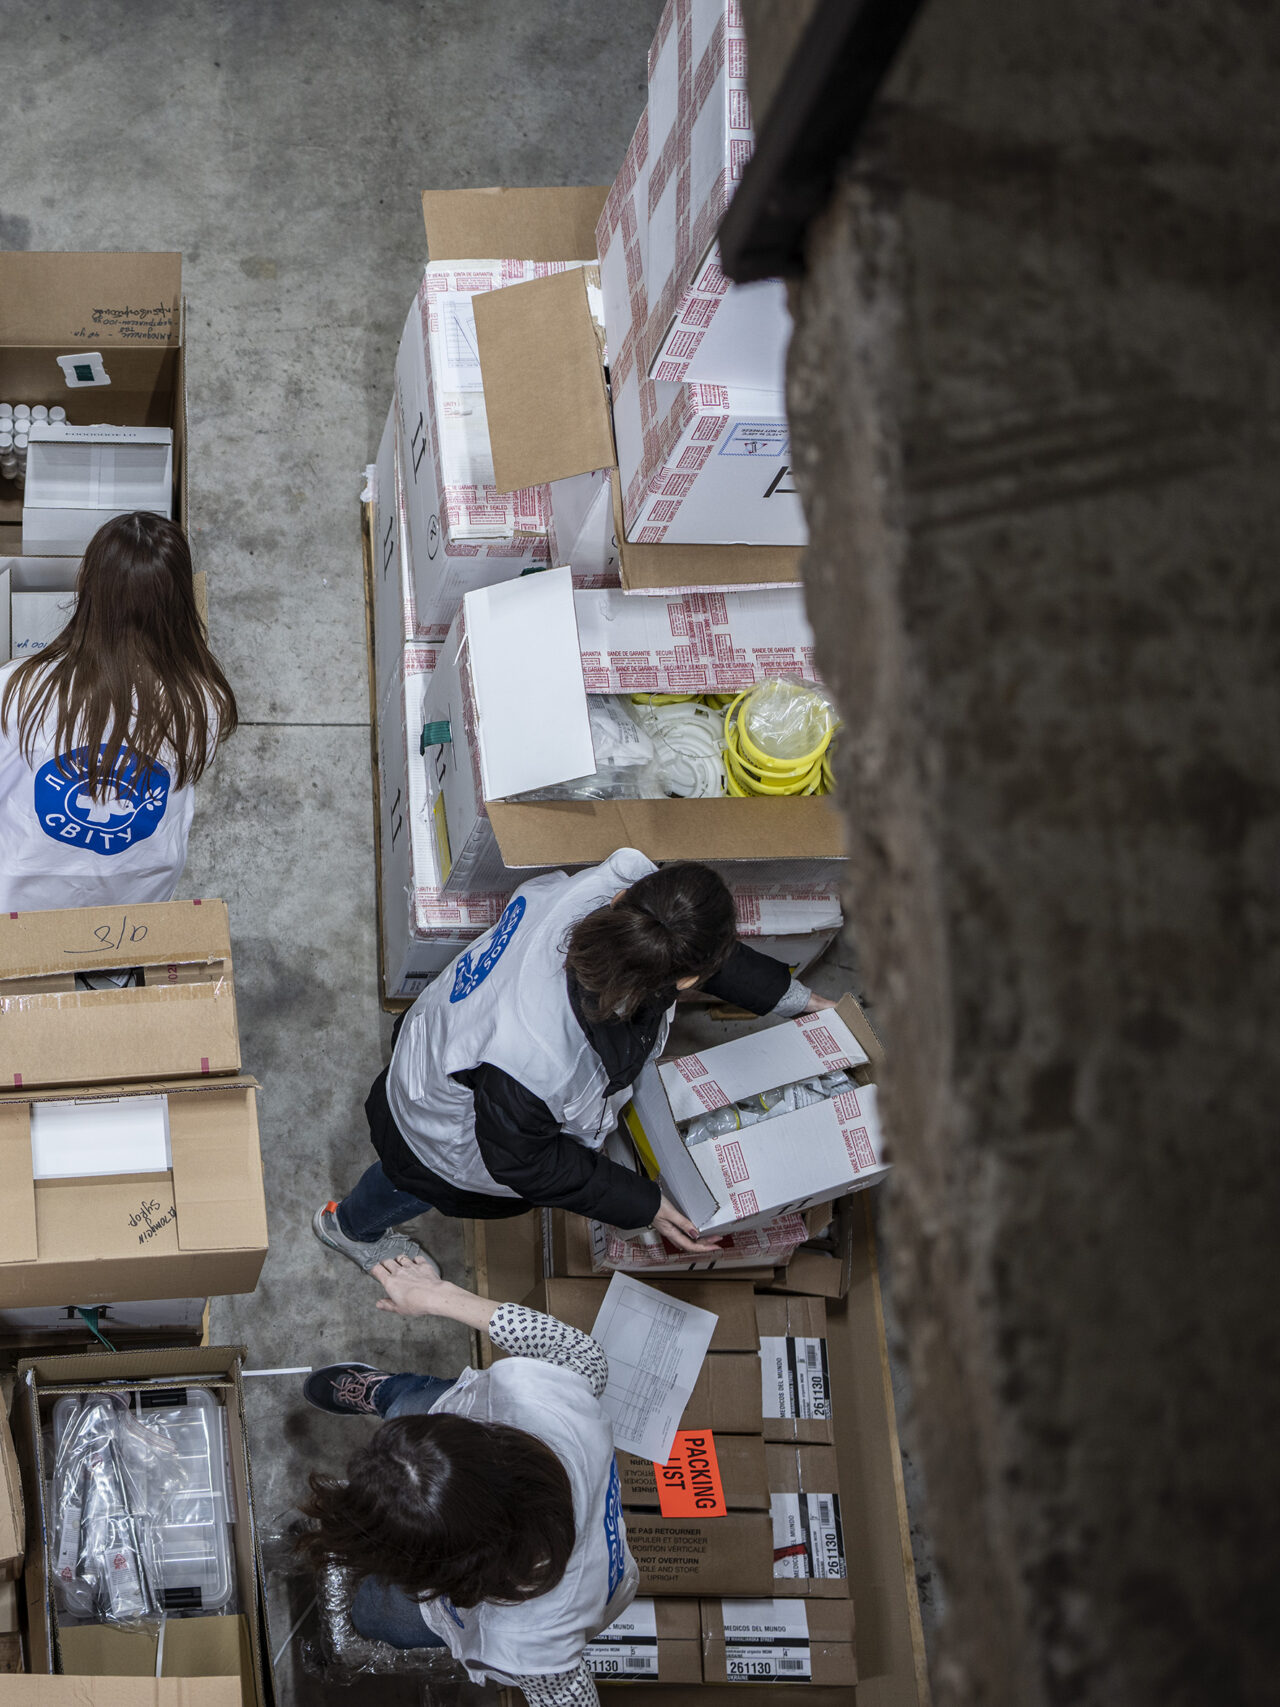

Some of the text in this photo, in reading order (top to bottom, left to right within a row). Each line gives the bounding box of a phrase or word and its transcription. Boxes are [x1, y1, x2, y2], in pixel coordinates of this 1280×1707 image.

[45, 813, 132, 849] СВІТУ
[813, 1376, 825, 1417] 261130
[685, 1438, 717, 1509] PACKING
[826, 1532, 839, 1575] 261130
[585, 1660, 618, 1672] 61130
[730, 1662, 771, 1675] 261130
